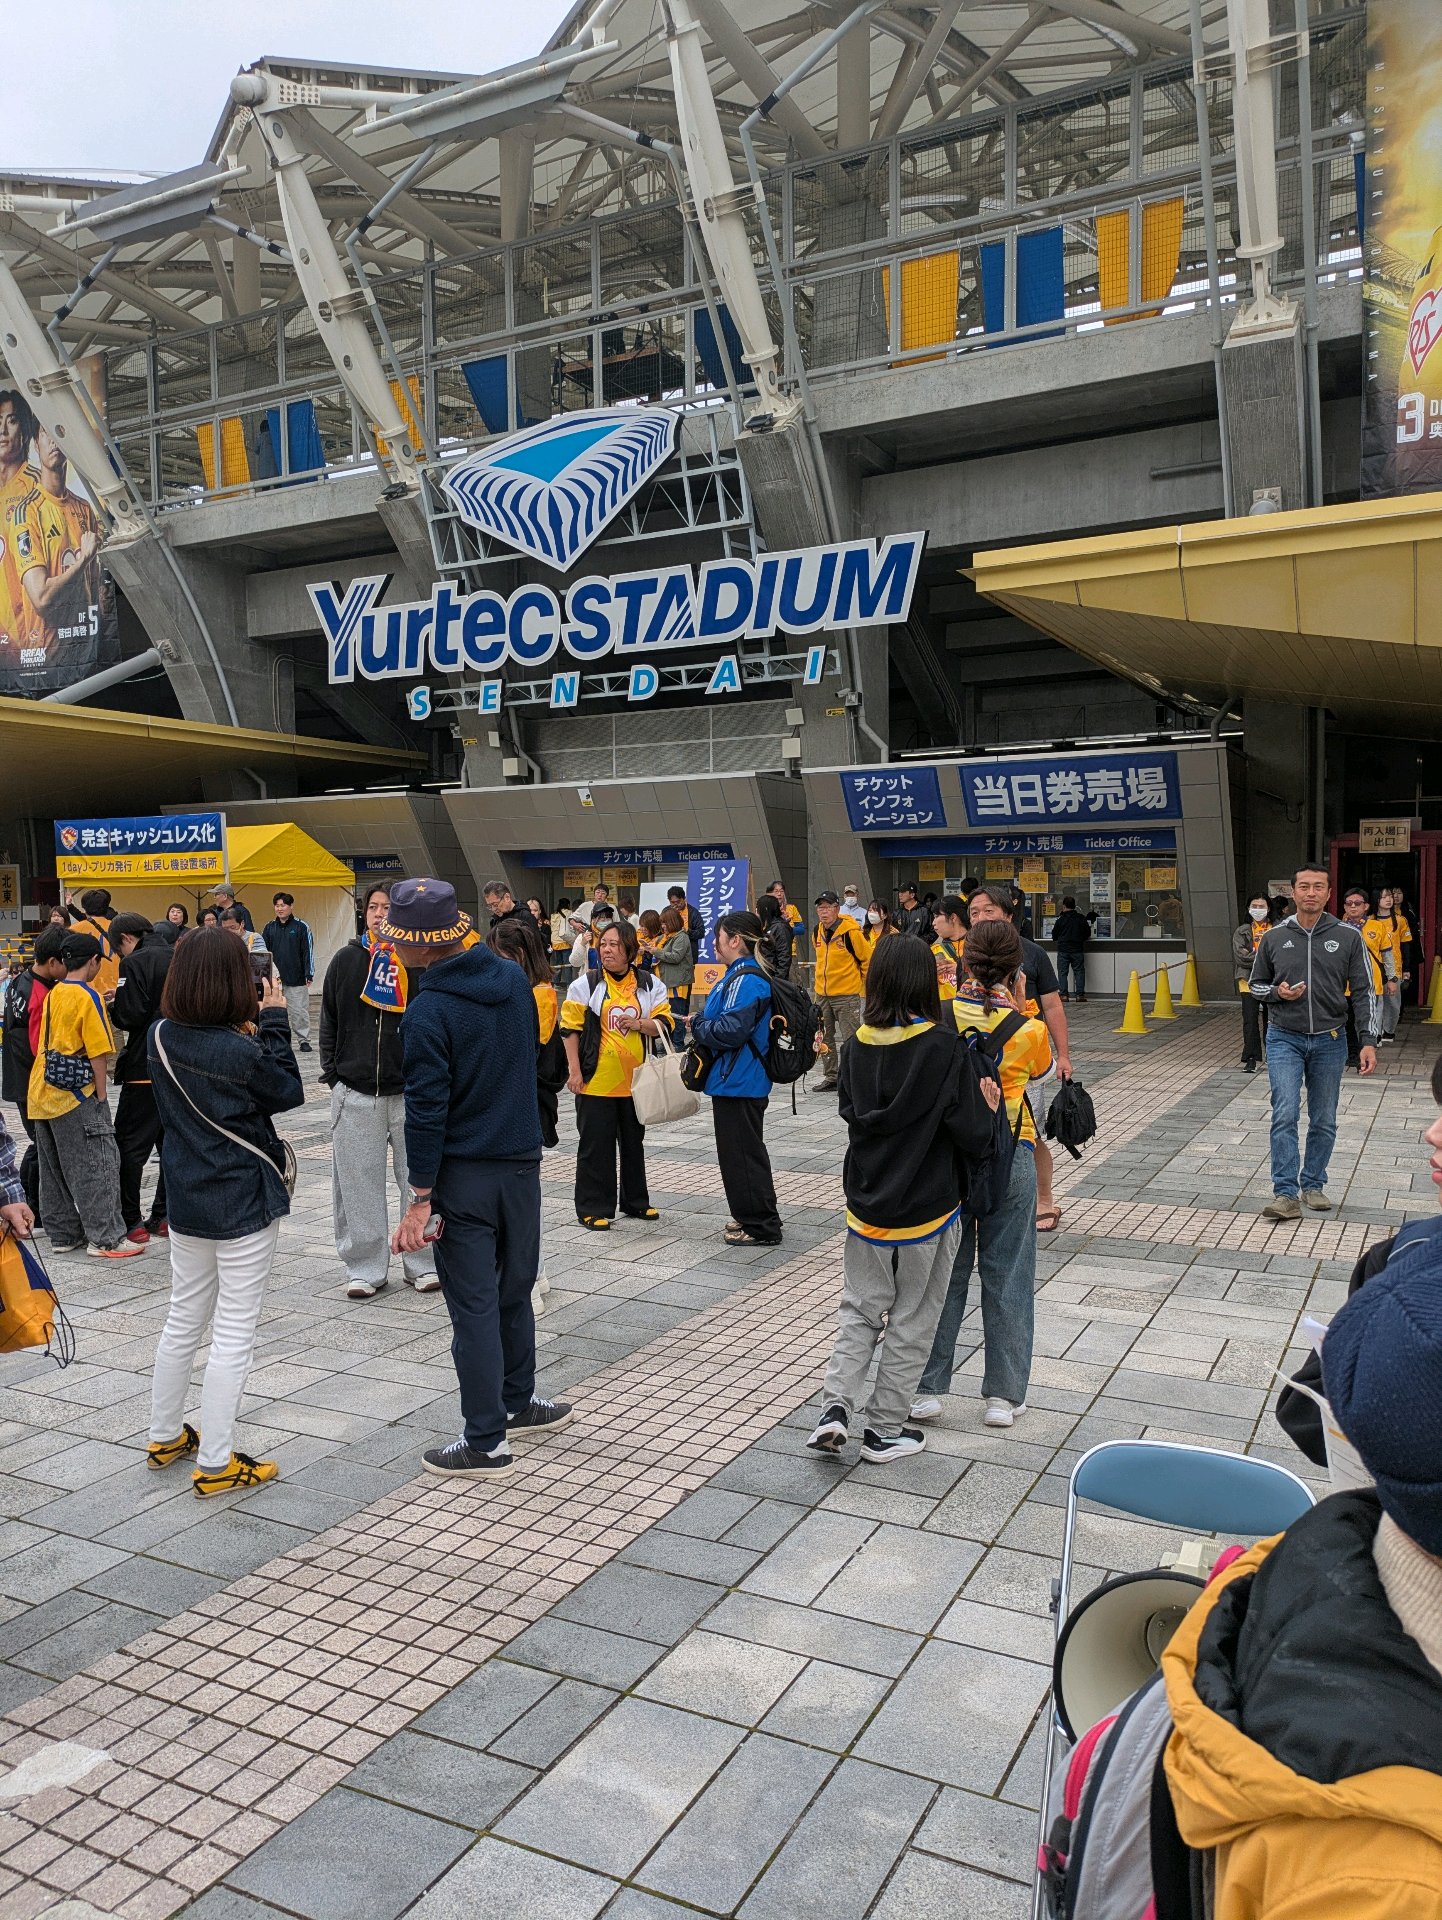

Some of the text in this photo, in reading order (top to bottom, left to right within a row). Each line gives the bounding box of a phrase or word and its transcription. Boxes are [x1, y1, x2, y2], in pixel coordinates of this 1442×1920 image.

[1368, 62, 1385, 381] MASAYUKI OKUYAMA
[1396, 391, 1425, 443] 3
[78, 612, 87, 623] DF
[88, 604, 99, 636] 5
[313, 541, 916, 678] Yurtec STADIUM
[20, 647, 47, 658] BREAK
[411, 650, 820, 718] SENDAI
[853, 774, 913, 792] チケット
[973, 766, 1168, 816] 当日券売場
[858, 794, 915, 809] インフォ
[863, 811, 933, 826] メーション
[81, 822, 216, 848] 完全キャッシュレス化
[985, 835, 1152, 852] チケット売場 Ticket Office
[1373, 837, 1396, 847] 出口
[143, 856, 218, 872] 払戻し機設置場所
[603, 849, 728, 863] チケット売場 Ticket Office
[717, 866, 736, 918] ソシオ
[379, 917, 471, 943] SENDAI VEGALTA
[374, 962, 400, 987] 42
